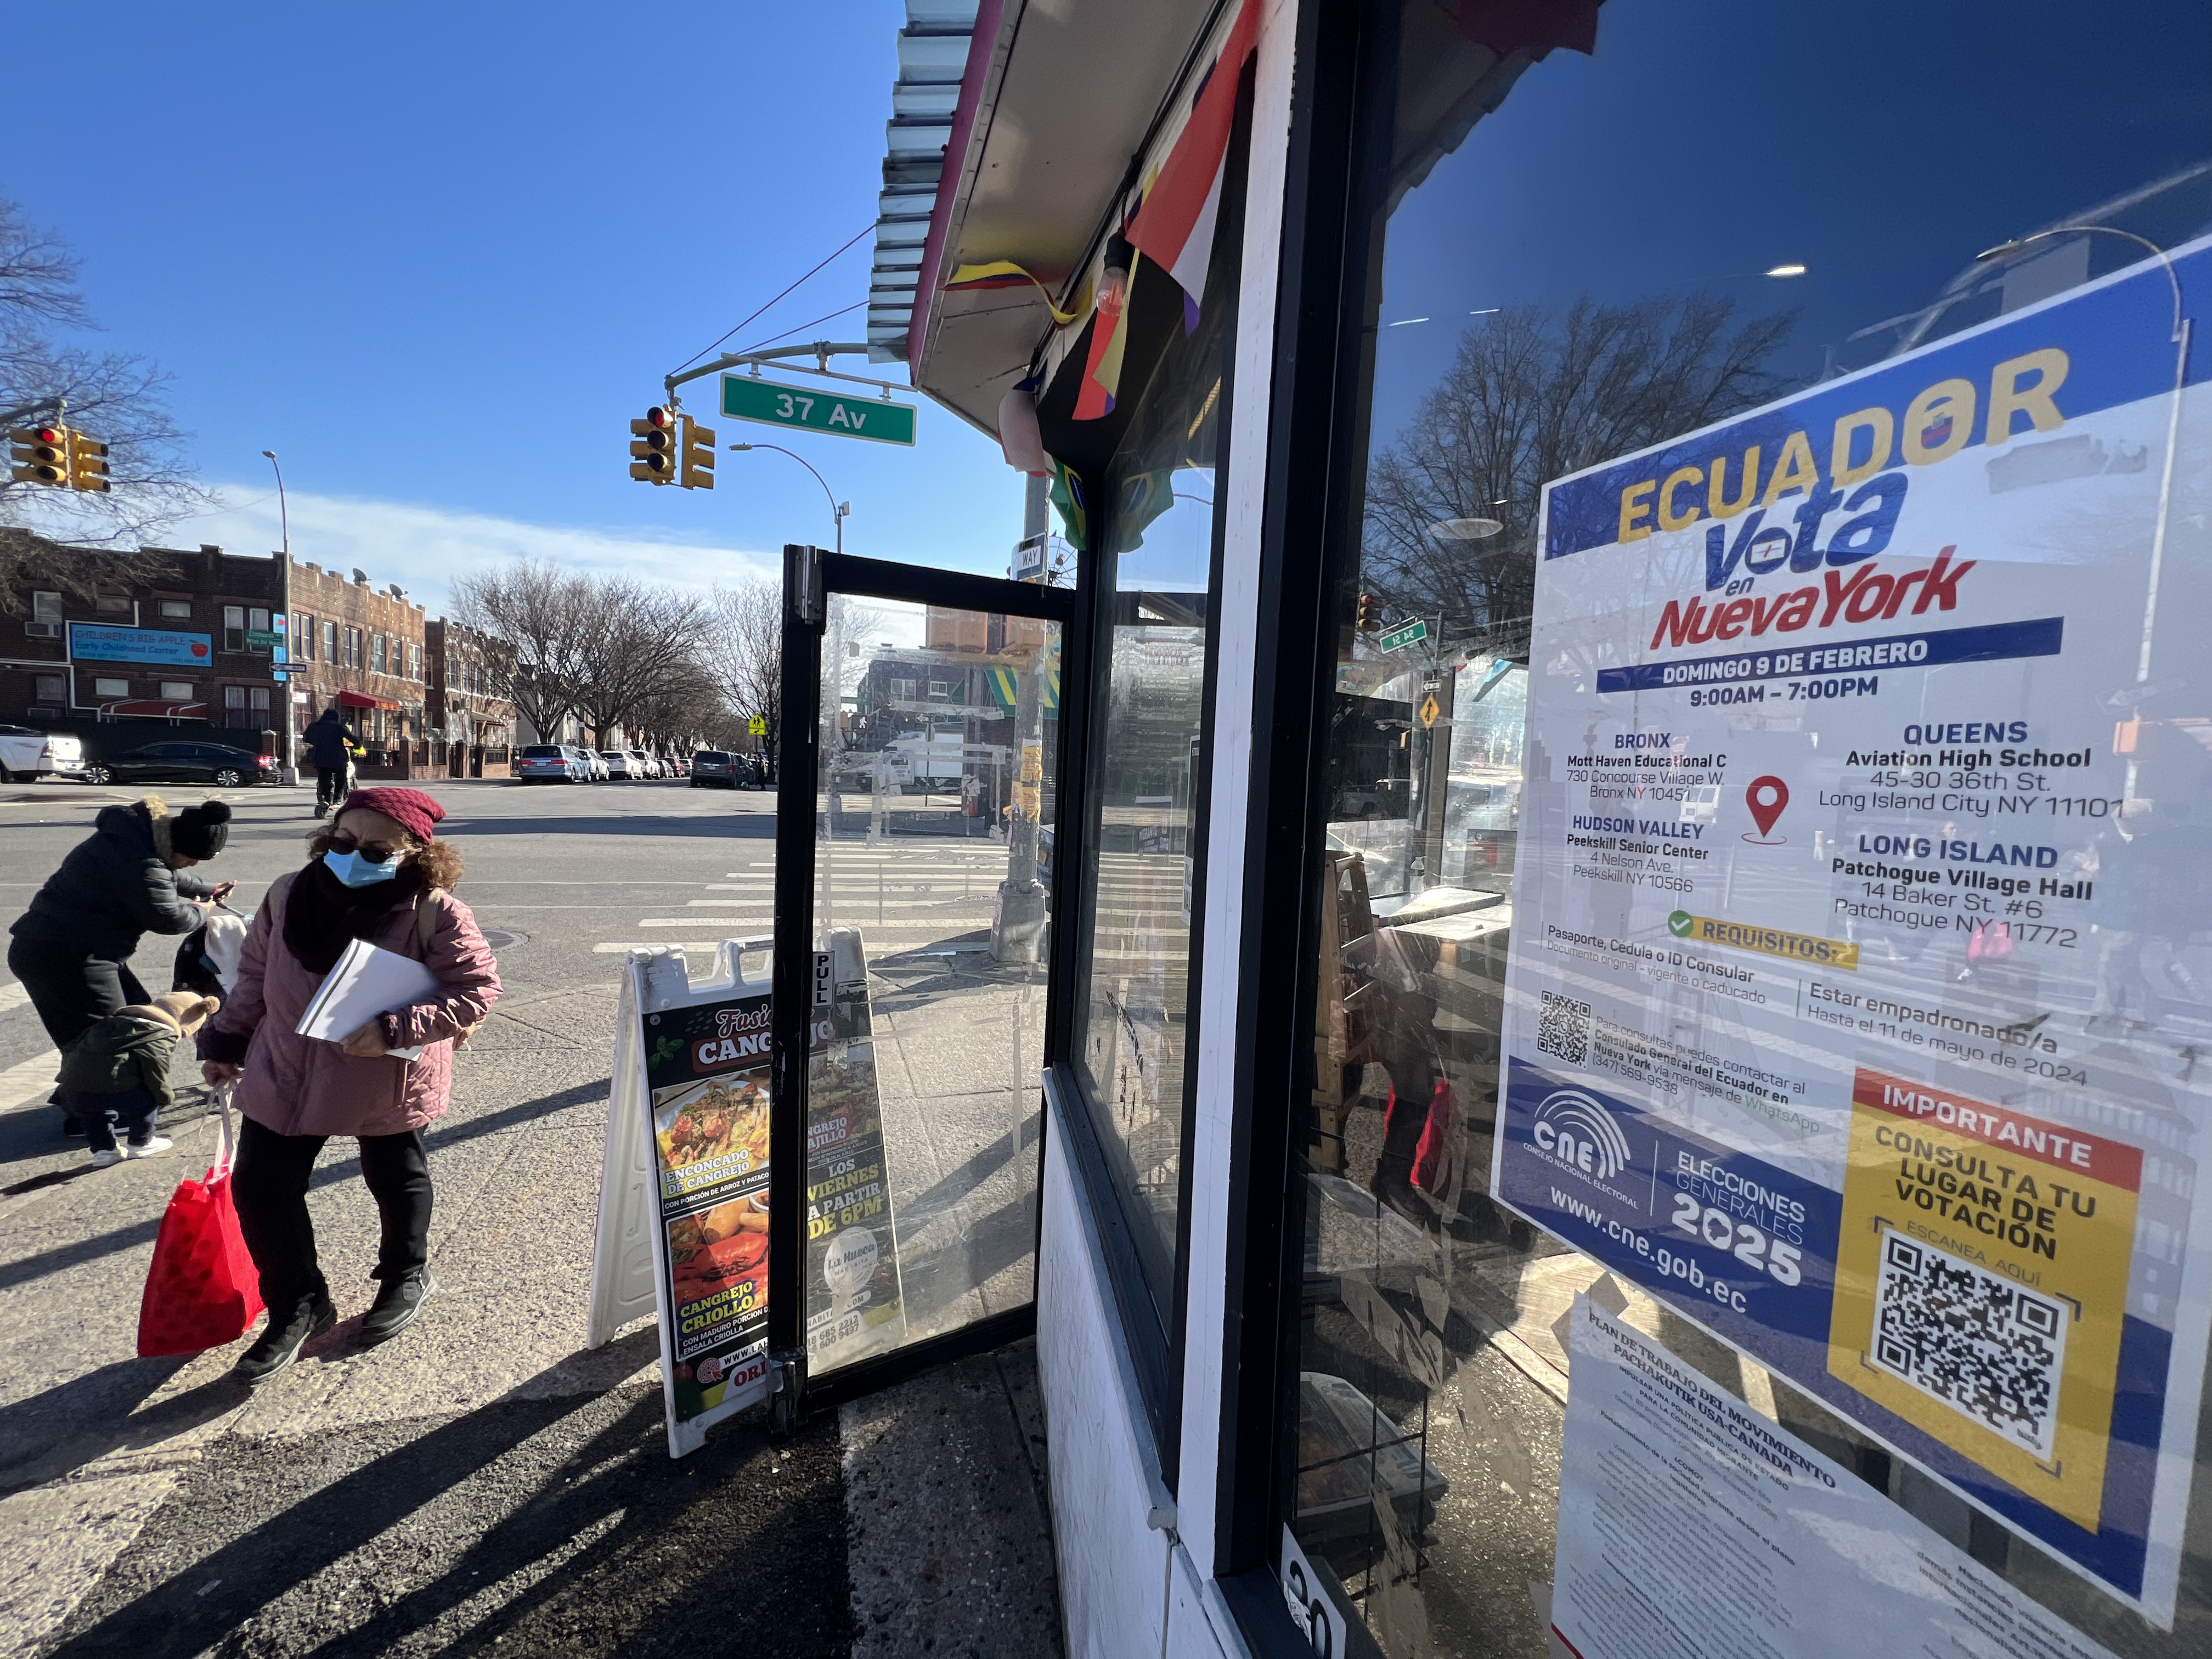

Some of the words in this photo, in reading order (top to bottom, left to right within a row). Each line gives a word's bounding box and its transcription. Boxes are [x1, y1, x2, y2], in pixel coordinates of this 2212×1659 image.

[776, 394, 814, 421] 37
[828, 404, 867, 429] Av
[1618, 347, 2070, 545] ECUADOR
[1705, 471, 1908, 592] Vota
[1023, 549, 1038, 567] WAY
[1725, 575, 1754, 596] en
[75, 630, 135, 641] CHILDREN'S
[138, 634, 156, 643] BIG
[158, 636, 185, 646] APPLE
[75, 641, 99, 651] Early
[102, 642, 145, 653] Childhood
[149, 646, 179, 654] Center
[1663, 660, 1751, 685] DOMINGO
[1756, 657, 1770, 676] 9
[1774, 651, 1804, 674] DE
[1808, 639, 1928, 670] FEBRERO
[1690, 685, 1764, 708] 9:00AM
[1786, 676, 1878, 703] 7:00PM
[1615, 733, 1671, 749] BRONX
[1904, 721, 2028, 746] QUEENS
[1567, 755, 1593, 768] Mott
[1596, 755, 1631, 768] Haven
[1634, 754, 1712, 768] Educational
[1716, 754, 1727, 768] C
[1567, 770, 1589, 783] 730
[1591, 770, 1656, 784] Concourse
[1660, 771, 1704, 787] Village
[1707, 772, 1725, 786] W.
[1846, 749, 1932, 768] Aviation
[1939, 749, 1992, 771] High
[1999, 748, 2091, 768] School
[1590, 786, 1623, 799] Bronx
[1627, 786, 1647, 800] NY
[1649, 788, 1690, 802] 10451
[1870, 771, 1940, 788] 45-30
[1949, 771, 2007, 791] 36th
[2016, 771, 2051, 792] St.
[1819, 791, 1866, 812] Long
[1872, 792, 1934, 811] Island
[1942, 794, 1990, 817] City
[1998, 796, 2038, 814] NY
[2045, 797, 2125, 818] 11101
[1573, 815, 1634, 834] HUDSON
[1639, 820, 1704, 839] VALLEY
[1567, 833, 1616, 850] Peekskill
[1619, 838, 1659, 855] Senior
[1662, 842, 1709, 860] Center
[1590, 851, 1599, 862] 4
[1601, 852, 1643, 869] Nelson
[1646, 858, 1674, 873] Ave.
[1859, 834, 1931, 859] LONG
[1939, 839, 2058, 868] ISLAND
[1573, 864, 1623, 883] Peekskill
[1626, 871, 1645, 885] NY
[1648, 874, 1694, 893] 10566
[1832, 857, 1940, 885] Patchogue
[1947, 868, 2031, 898] Village
[2039, 877, 2092, 900] Hall
[1862, 882, 1886, 899] 14
[1892, 884, 1957, 909] Baker
[1963, 893, 1995, 913] St.
[2005, 900, 2044, 919] #6
[1835, 899, 1948, 930] Patchogue
[1955, 915, 1993, 934] NY
[2000, 921, 2078, 949] 11772
[1547, 940, 1599, 962] Documento
[1601, 953, 1637, 972] original
[1647, 966, 1689, 986] vigente
[1702, 978, 1766, 1005] caducado
[1548, 925, 1607, 951] Pasaporte,
[1610, 936, 1653, 960] Cédula
[1668, 951, 1682, 966] ID
[1686, 956, 1755, 983] Consular
[816, 955, 830, 1003] PULL
[1810, 983, 1862, 1007] Estar
[1866, 996, 2057, 1053] empadronado/a
[1596, 1015, 1618, 1033] Para
[1621, 1025, 1673, 1051] consultas
[1676, 1043, 1720, 1068] puedes
[1723, 1059, 1790, 1090] contactar
[1792, 1081, 1805, 1095] al
[1808, 1005, 1854, 1028] Hasta
[1859, 1017, 1873, 1033] el
[1879, 1023, 1896, 1039] 11
[1901, 1026, 1924, 1044] de
[1928, 1035, 1984, 1063] mayo
[1990, 1049, 2017, 1069] de
[2023, 1057, 2087, 1087] 2024
[1593, 1053, 1619, 1073] (347)
[1620, 1063, 1678, 1096] 569-9538
[1595, 1029, 1646, 1056] Consulado
[1649, 1048, 1692, 1071] General
[1695, 1063, 1713, 1079] del
[1716, 1071, 1769, 1098] Ecuador
[1772, 1091, 1788, 1105] en
[1594, 1042, 1623, 1062] Nueva
[1627, 1054, 1651, 1071] York
[1672, 1070, 1723, 1098] mensaje
[1726, 1089, 1741, 1104] de
[1745, 1096, 1820, 1135] WhatsApp
[1883, 1084, 2092, 1168] IMPORTANTE
[665, 1148, 749, 1183] ENCONCADO
[667, 1182, 685, 1196] DE
[686, 1161, 750, 1189] CANGREJO
[808, 1163, 879, 1201] VIERNES
[828, 1159, 855, 1178] LOS
[1523, 1142, 1554, 1165] CONSEJO
[1554, 1158, 1592, 1184] NACIONAL
[1593, 1179, 1639, 1210] ELECTORAL
[1876, 1125, 2038, 1199] CONSULTA
[2050, 1183, 2096, 1218] TU
[664, 1200, 679, 1209] CON
[680, 1190, 709, 1205] PORCIÓN
[720, 1181, 741, 1193] ARROZ
[808, 1205, 820, 1221] A
[823, 1182, 881, 1215] PARTIR
[1678, 1150, 1805, 1224] ELECCIONES
[1901, 1158, 2001, 1212] LUGAR
[2012, 1199, 2057, 1233] DE
[808, 1212, 836, 1240] DE
[841, 1195, 882, 1225] 6PM
[1677, 1171, 1803, 1245] GENERALES
[1895, 1179, 2057, 1261] VOTACIÓN
[828, 1257, 842, 1270] La
[844, 1243, 876, 1263] Hueca
[1551, 1186, 1747, 1314] www.cne.gob.ec
[1672, 1192, 1802, 1286] 2025
[1907, 1221, 1987, 1264] ESCANEA
[1995, 1259, 2042, 1286] AQUÍ
[680, 1281, 753, 1318] CANGREJO
[681, 1295, 754, 1334] CRIOLLO
[683, 1335, 699, 1347] CON
[700, 1322, 731, 1340] MADURO
[732, 1308, 763, 1326] PORCION
[684, 1339, 714, 1356] ENSALA
[714, 1325, 744, 1342] CRIOLLA
[819, 1327, 836, 1341] 685
[839, 1315, 859, 1331] 2212
[820, 1335, 836, 1350] 600
[839, 1323, 859, 1340] 9497
[1589, 1312, 1618, 1339] PLAN
[1621, 1333, 1637, 1351] DE
[1641, 1347, 1697, 1392] TRABAJO
[1700, 1388, 1725, 1413] DEL
[1729, 1409, 1836, 1488] MOVIMIENTO
[1613, 1344, 1696, 1406] PACHAKUTIK
[1698, 1403, 1793, 1476] USA-CANADA
